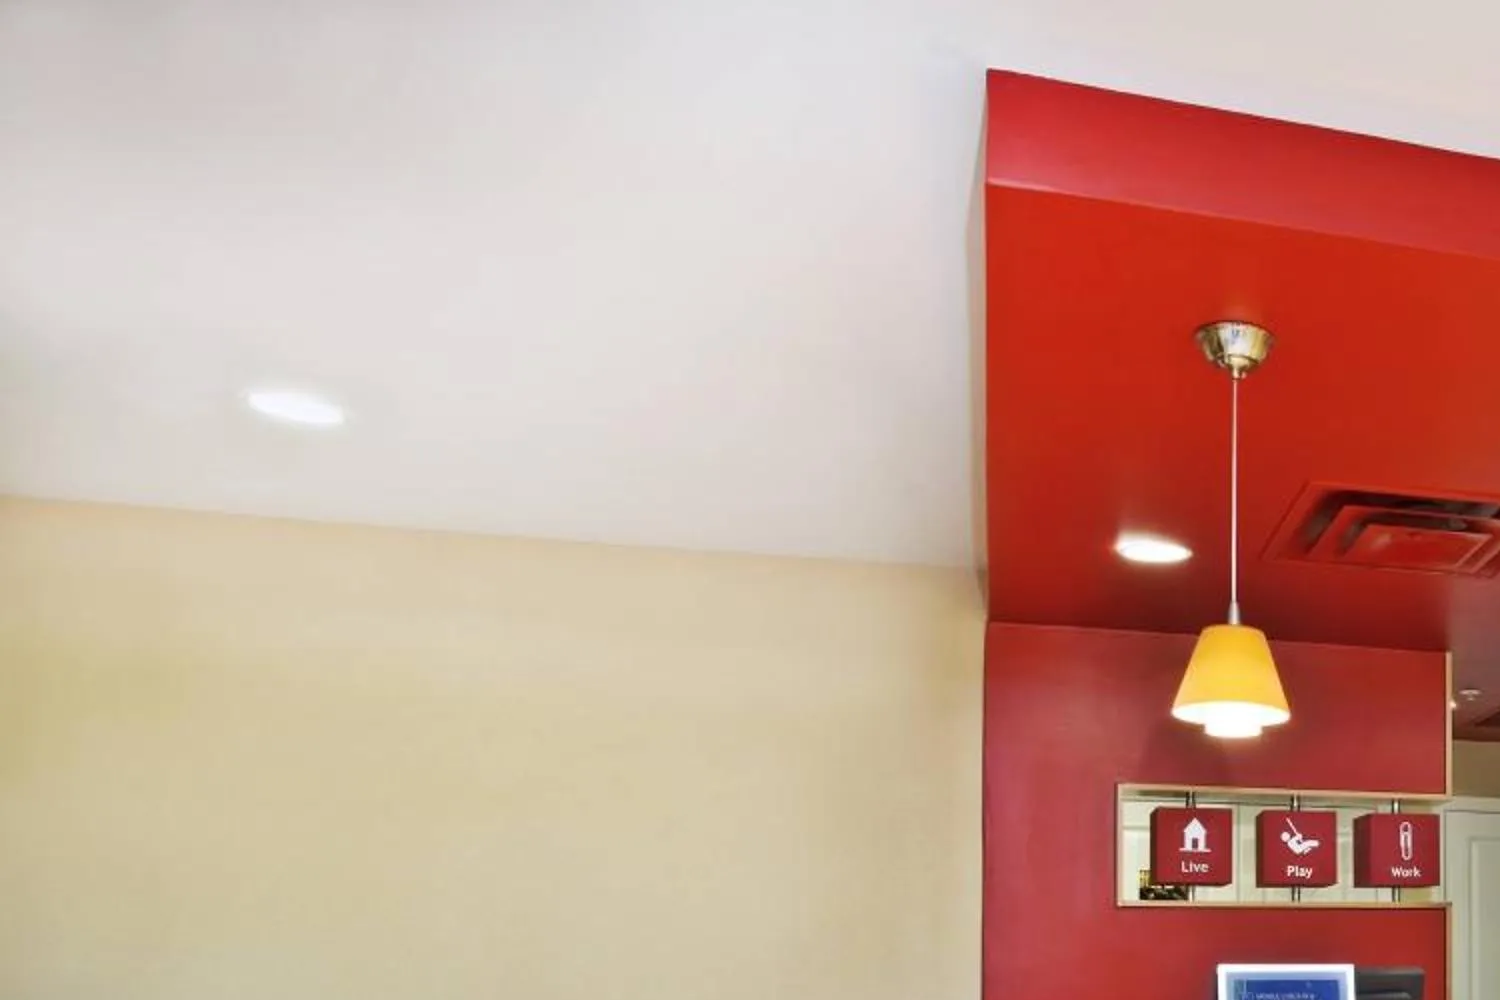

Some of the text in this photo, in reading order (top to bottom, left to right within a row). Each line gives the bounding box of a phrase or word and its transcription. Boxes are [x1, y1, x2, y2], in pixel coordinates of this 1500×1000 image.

[1181, 861, 1209, 873] Live
[1286, 865, 1313, 879] Play
[1391, 866, 1420, 878] Work
